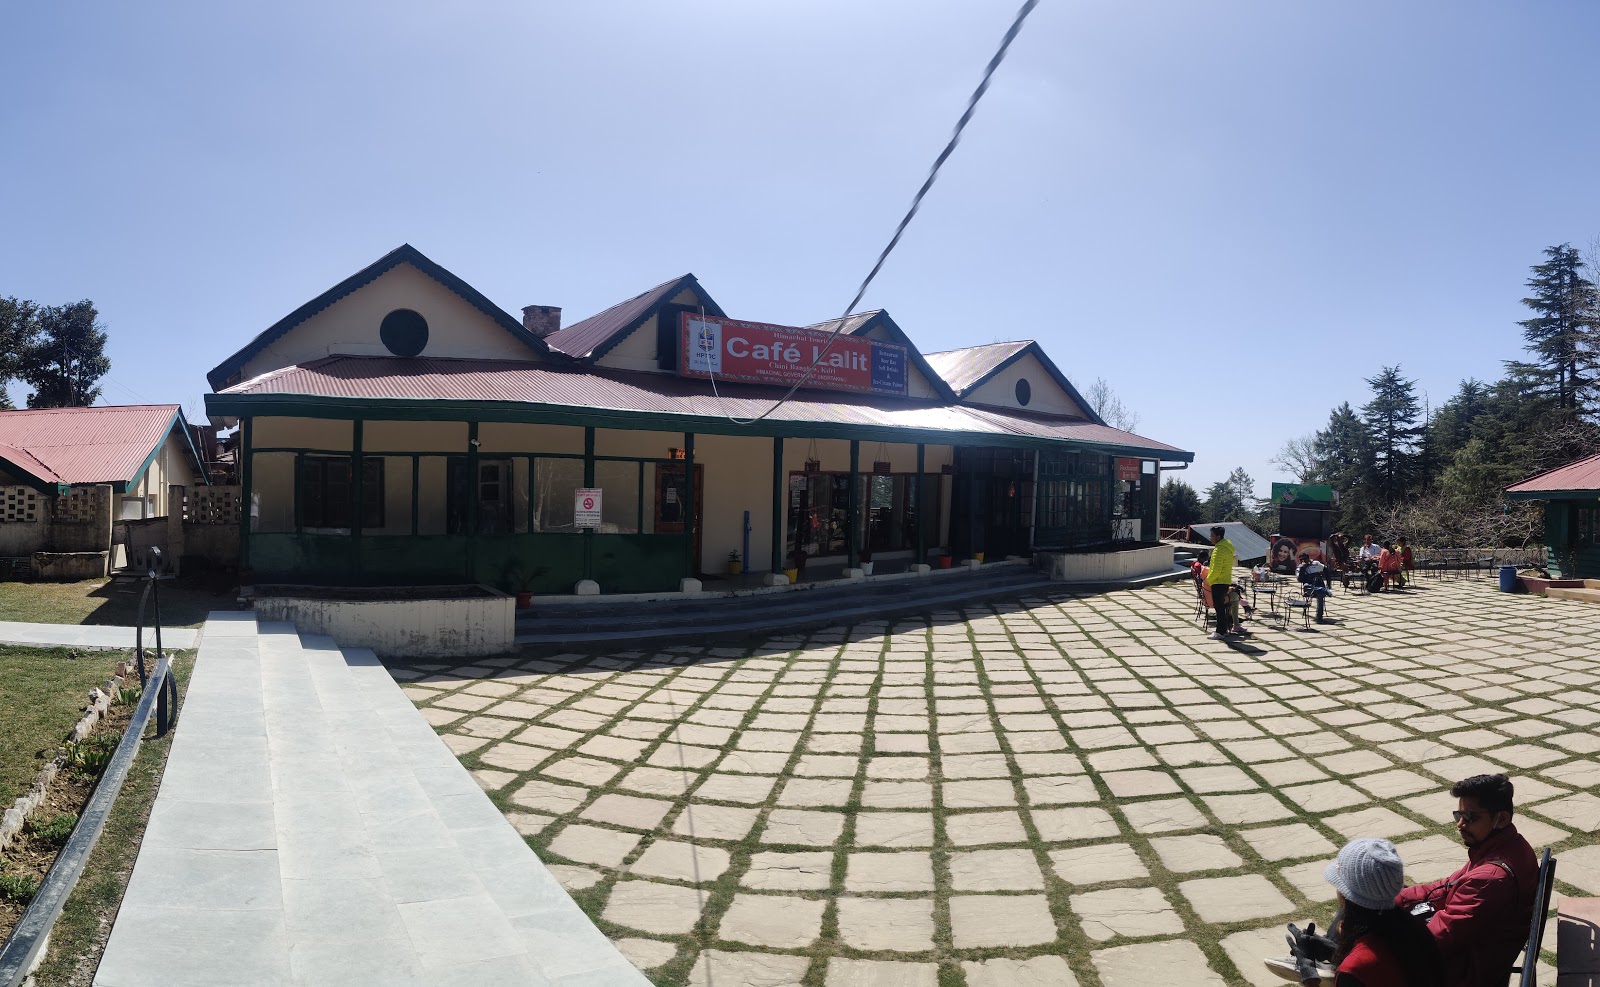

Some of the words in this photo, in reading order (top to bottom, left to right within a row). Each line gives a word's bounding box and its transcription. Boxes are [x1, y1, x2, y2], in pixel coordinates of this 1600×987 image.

[773, 332, 806, 342] Himachal
[726, 337, 800, 363] Café
[812, 345, 868, 372] Lalit
[769, 362, 788, 370] Chini
[756, 369, 782, 377] HIMACHAL
